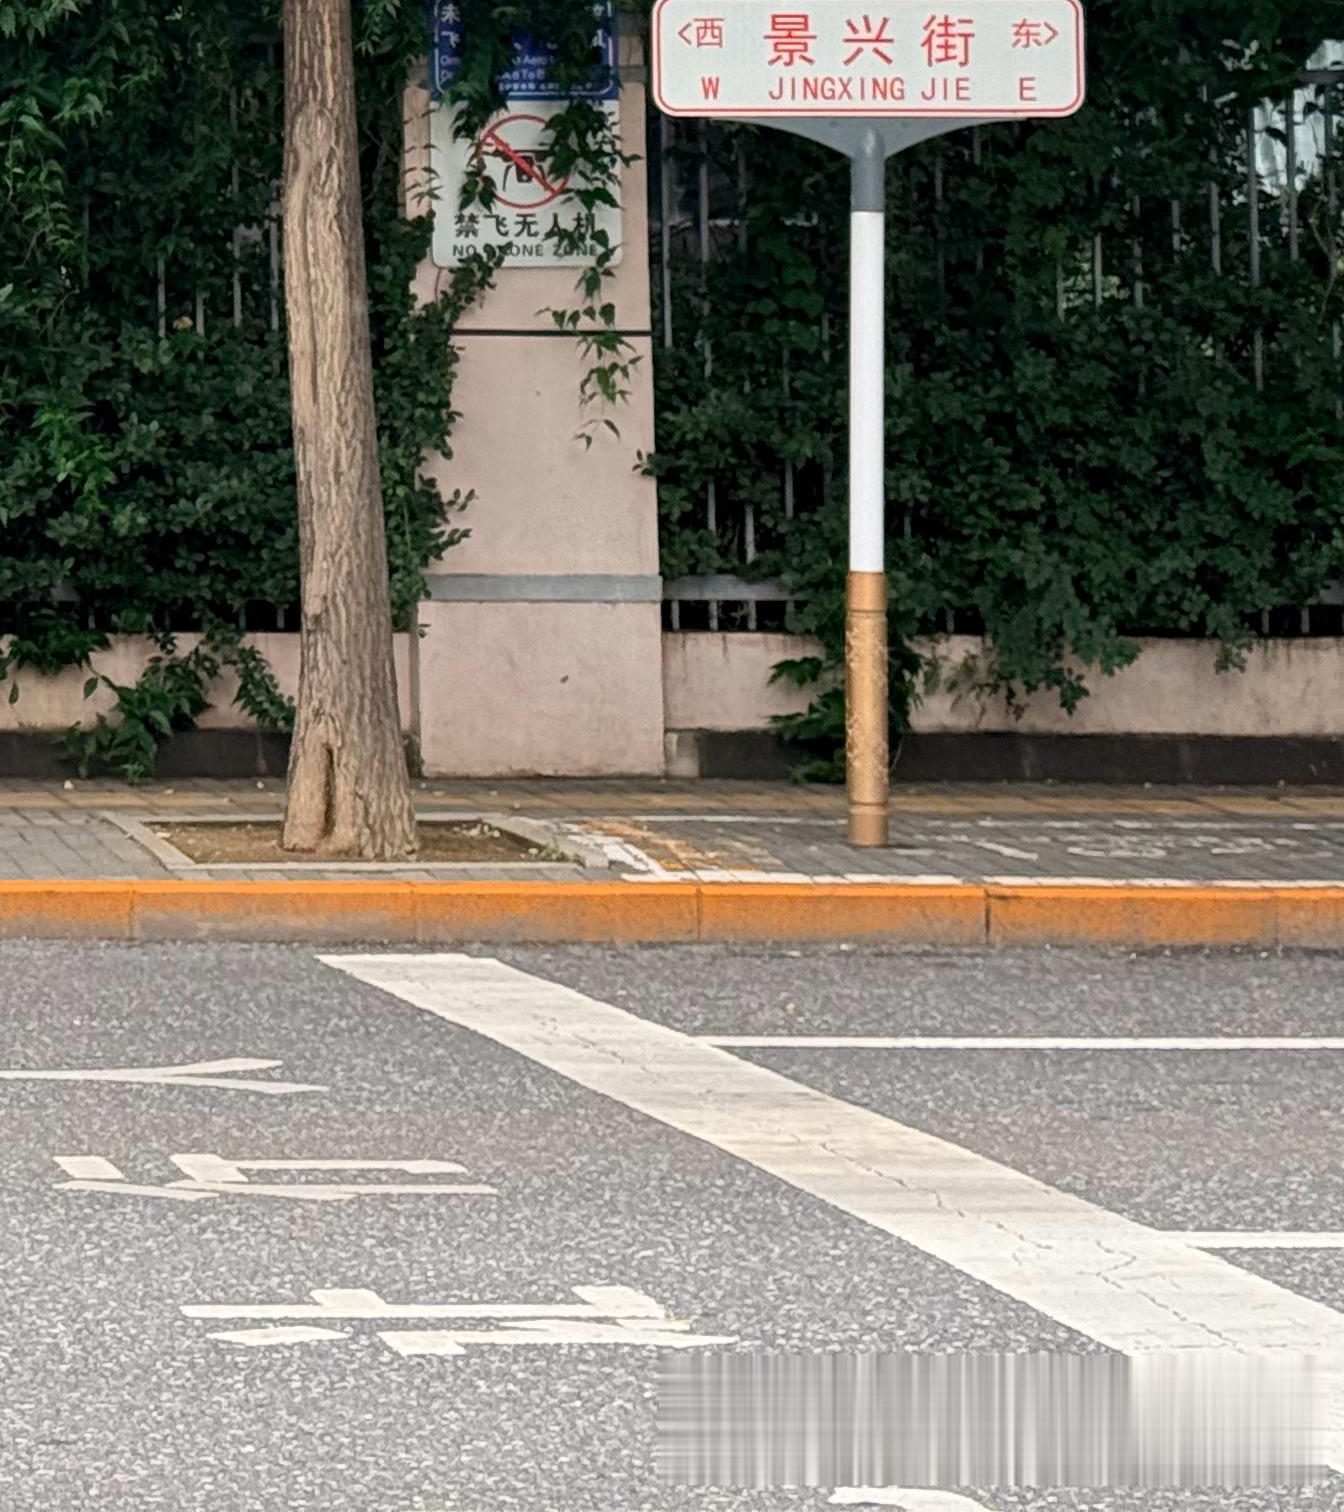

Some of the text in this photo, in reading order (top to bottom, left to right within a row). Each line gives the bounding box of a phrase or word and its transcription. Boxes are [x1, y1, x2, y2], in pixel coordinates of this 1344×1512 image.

[693, 13, 1043, 68] 西 景兴街 东
[701, 76, 1037, 102] W JINGXING JIE E
[454, 212, 597, 239] 禁飞无人机
[452, 244, 478, 258] NO
